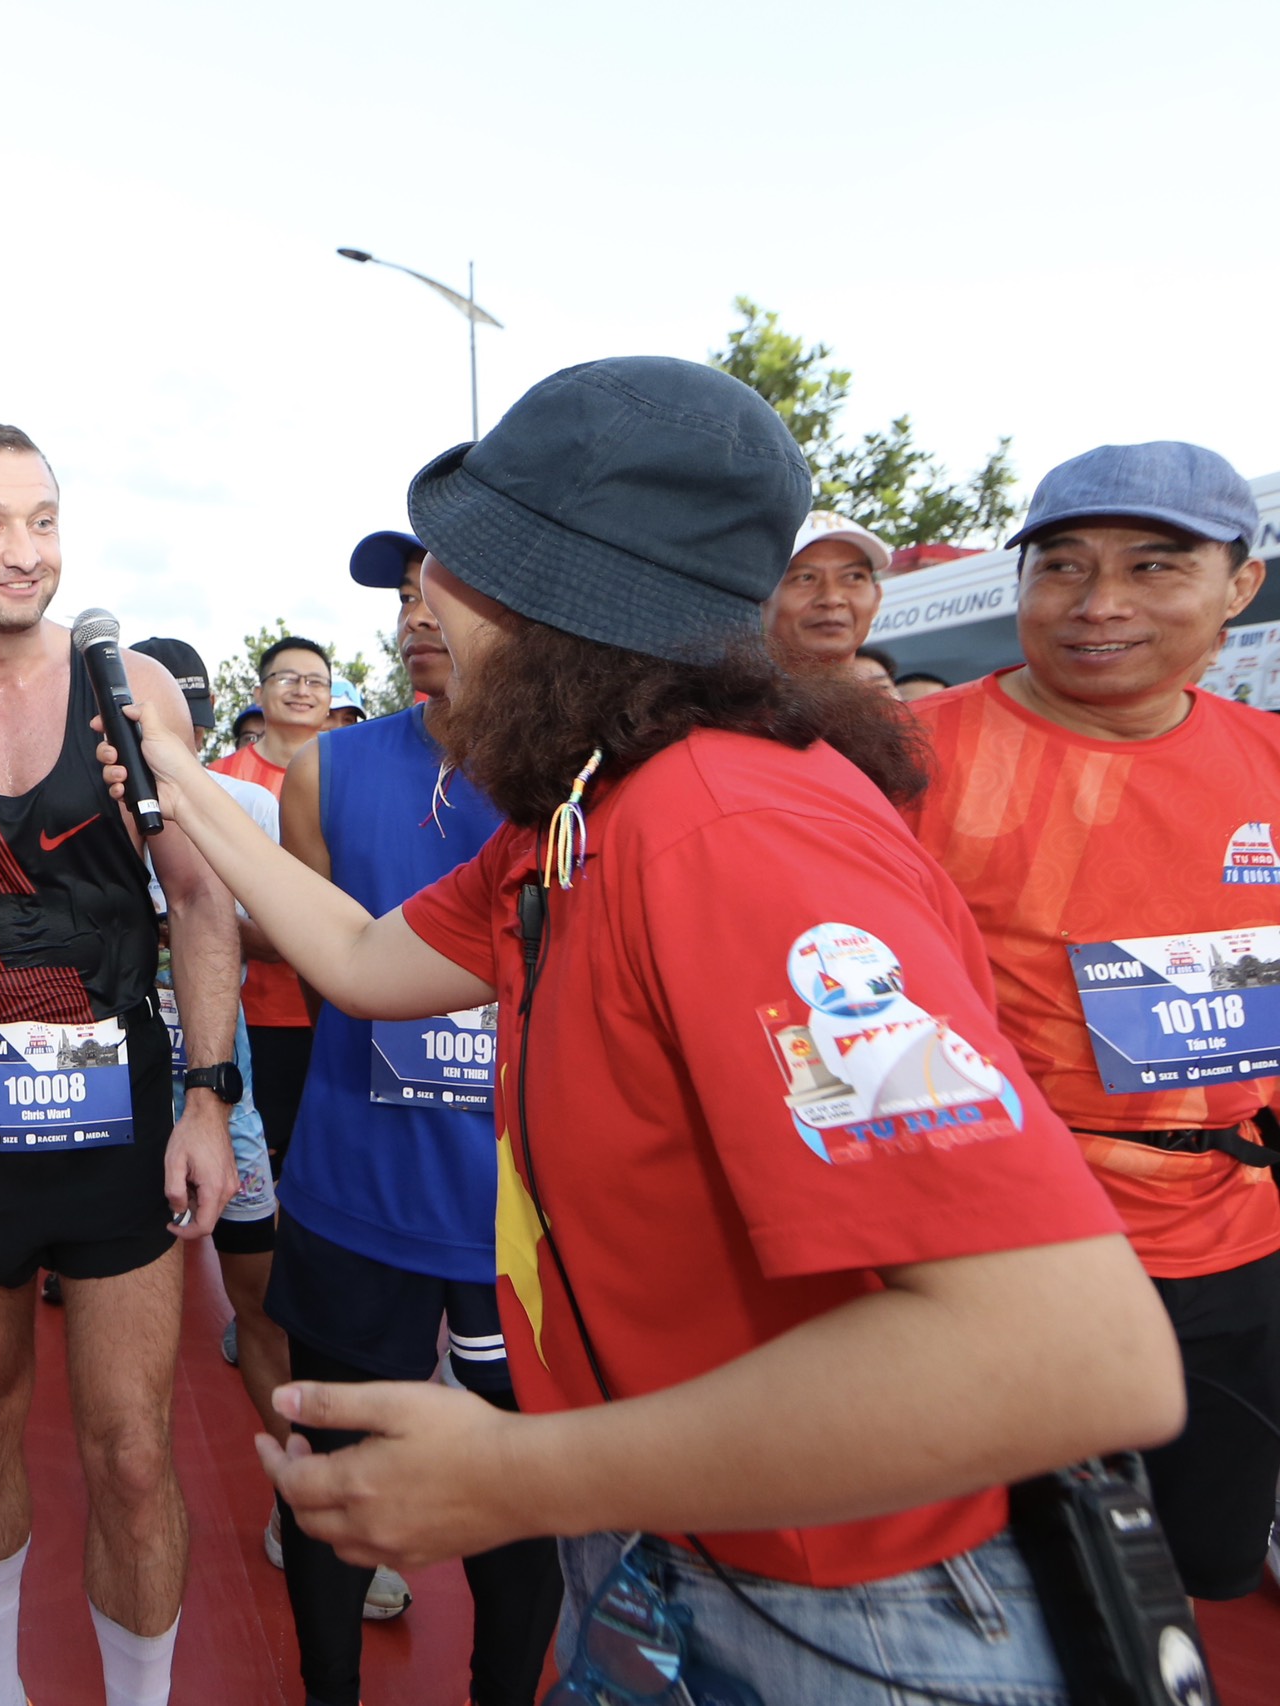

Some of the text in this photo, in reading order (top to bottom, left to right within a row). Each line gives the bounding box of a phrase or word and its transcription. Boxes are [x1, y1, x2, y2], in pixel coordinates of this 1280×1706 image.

[925, 588, 1005, 622] CHUNG
[1083, 960, 1144, 981] 10KM
[1151, 994, 1246, 1035] 10118
[421, 1030, 497, 1065] 1009
[443, 1066, 489, 1080] KEN THIEN
[1159, 1060, 1279, 1081] SIZE RACEKIT MEDAL
[4, 1072, 87, 1106] 10008
[416, 1090, 488, 1104] SIZE RACEKIT
[21, 1108, 71, 1121] Chris Ward
[3, 1131, 110, 1144] SIZE RACEKIT MEDAL
